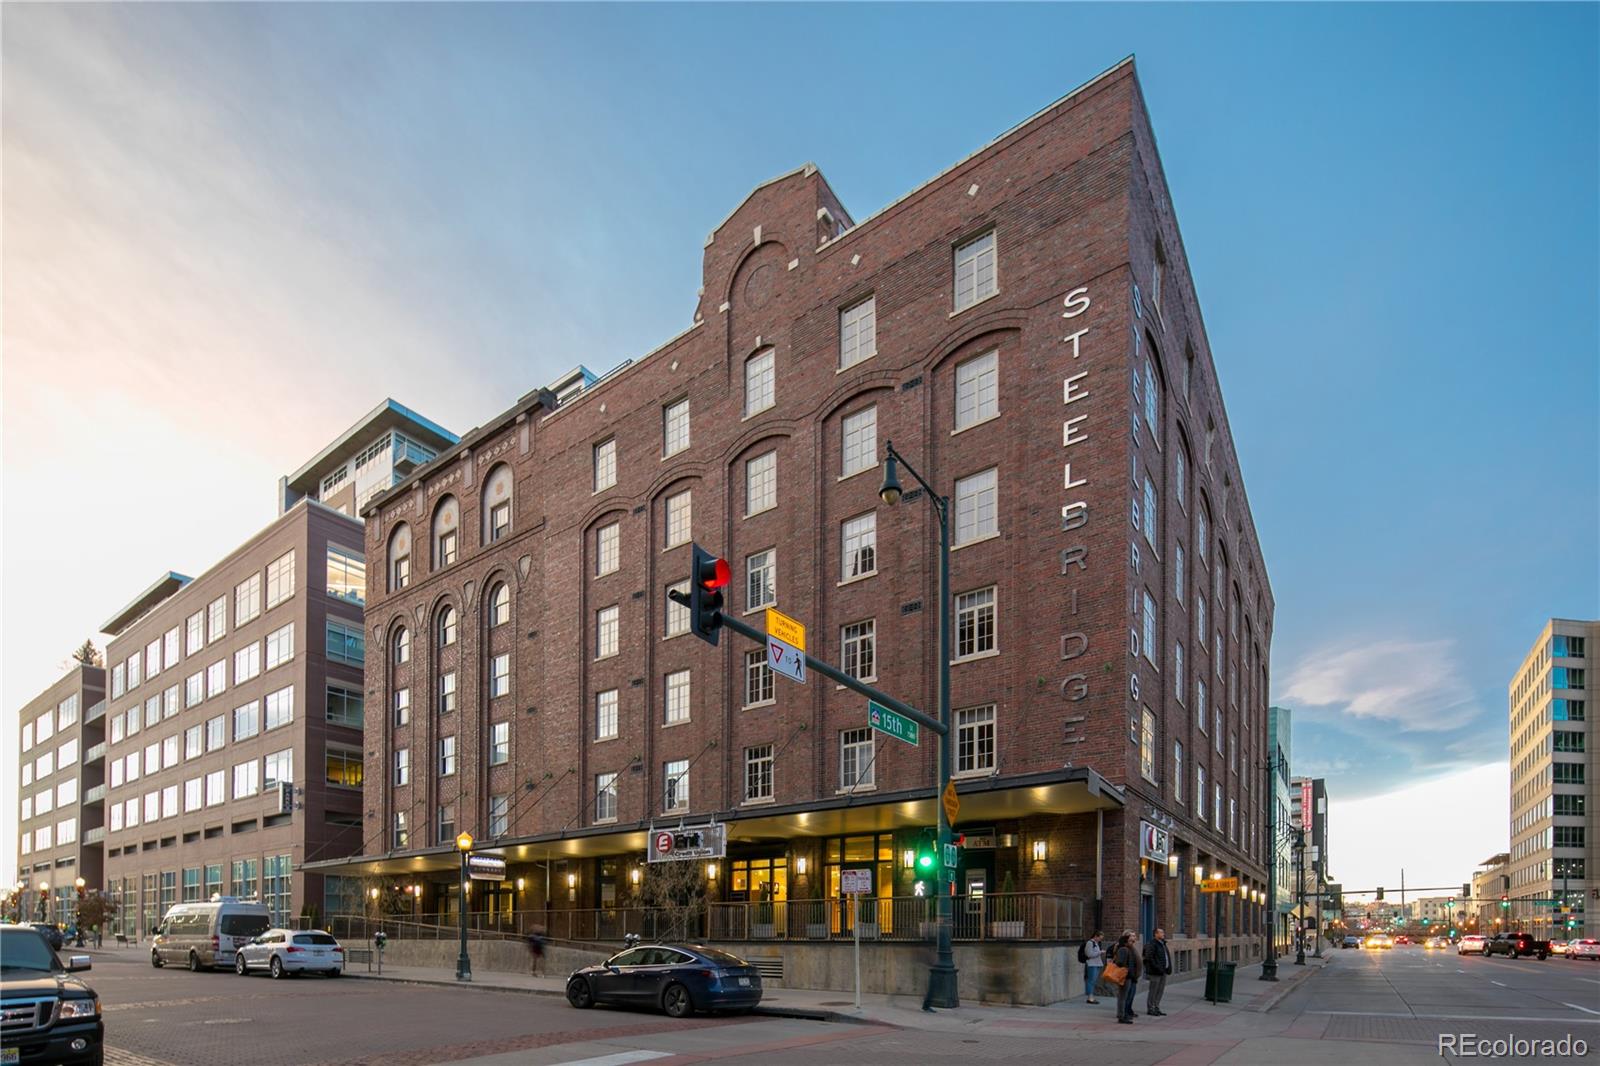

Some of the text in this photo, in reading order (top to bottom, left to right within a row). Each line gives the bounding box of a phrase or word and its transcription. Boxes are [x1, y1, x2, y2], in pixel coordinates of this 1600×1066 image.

[775, 616, 798, 634] TURNING
[774, 627, 799, 645] VEHICLES
[785, 655, 792, 665] TO
[882, 713, 903, 735] 15th
